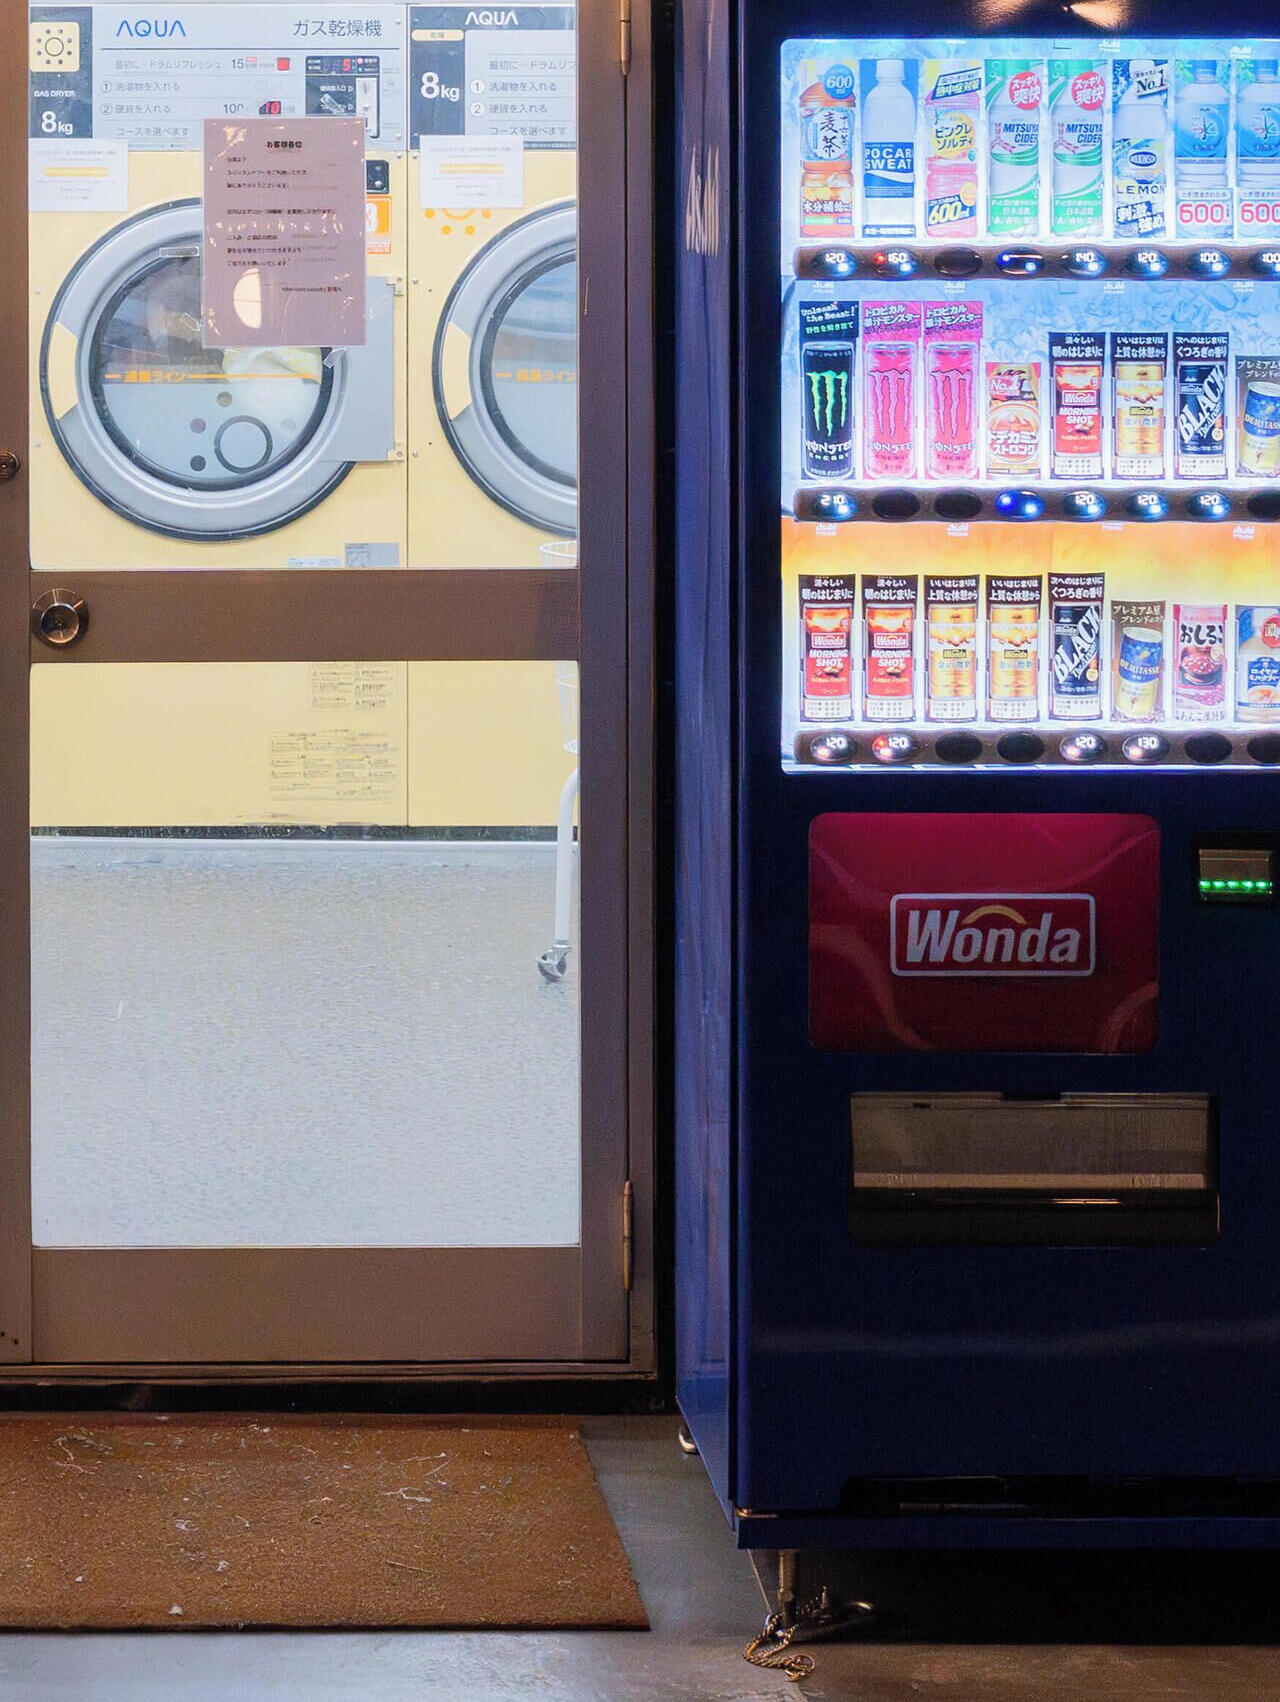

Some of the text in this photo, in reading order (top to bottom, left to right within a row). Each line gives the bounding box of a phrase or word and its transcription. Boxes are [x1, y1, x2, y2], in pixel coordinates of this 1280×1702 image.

[465, 11, 519, 26] AQUA
[116, 20, 187, 38] AQUA
[293, 19, 383, 37] ガス乾燥機
[826, 76, 852, 89] 600
[1136, 69, 1166, 94] No.1
[421, 72, 460, 102] 8kg
[34, 90, 76, 98] GAS DRYER
[41, 111, 73, 135] 8kg
[819, 111, 841, 158] 麦茶
[865, 159, 912, 170] SWEAT
[1179, 203, 1224, 223] 600
[825, 253, 845, 263] 120
[887, 253, 907, 263] 160
[1137, 253, 1157, 263] 120
[1200, 253, 1218, 263] 100
[1262, 253, 1280, 263] 100
[864, 304, 905, 318] トロピカル
[926, 304, 967, 318] トロピカル
[990, 380, 1021, 390] No.1
[992, 443, 1035, 455] ストロング
[1075, 495, 1095, 505] 120
[1137, 495, 1157, 505] 120
[1200, 495, 1219, 505] 120
[814, 636, 845, 646] Wonda
[876, 636, 907, 646] Wonda
[809, 650, 849, 658] MORNING
[871, 650, 911, 658] MORNING
[816, 659, 844, 667] SHOT
[878, 659, 906, 667] SHOT
[826, 737, 846, 747] 120
[888, 737, 908, 747] 120
[1075, 737, 1096, 747] 120
[1138, 737, 1158, 747] 130
[906, 910, 1081, 963] Wonda
